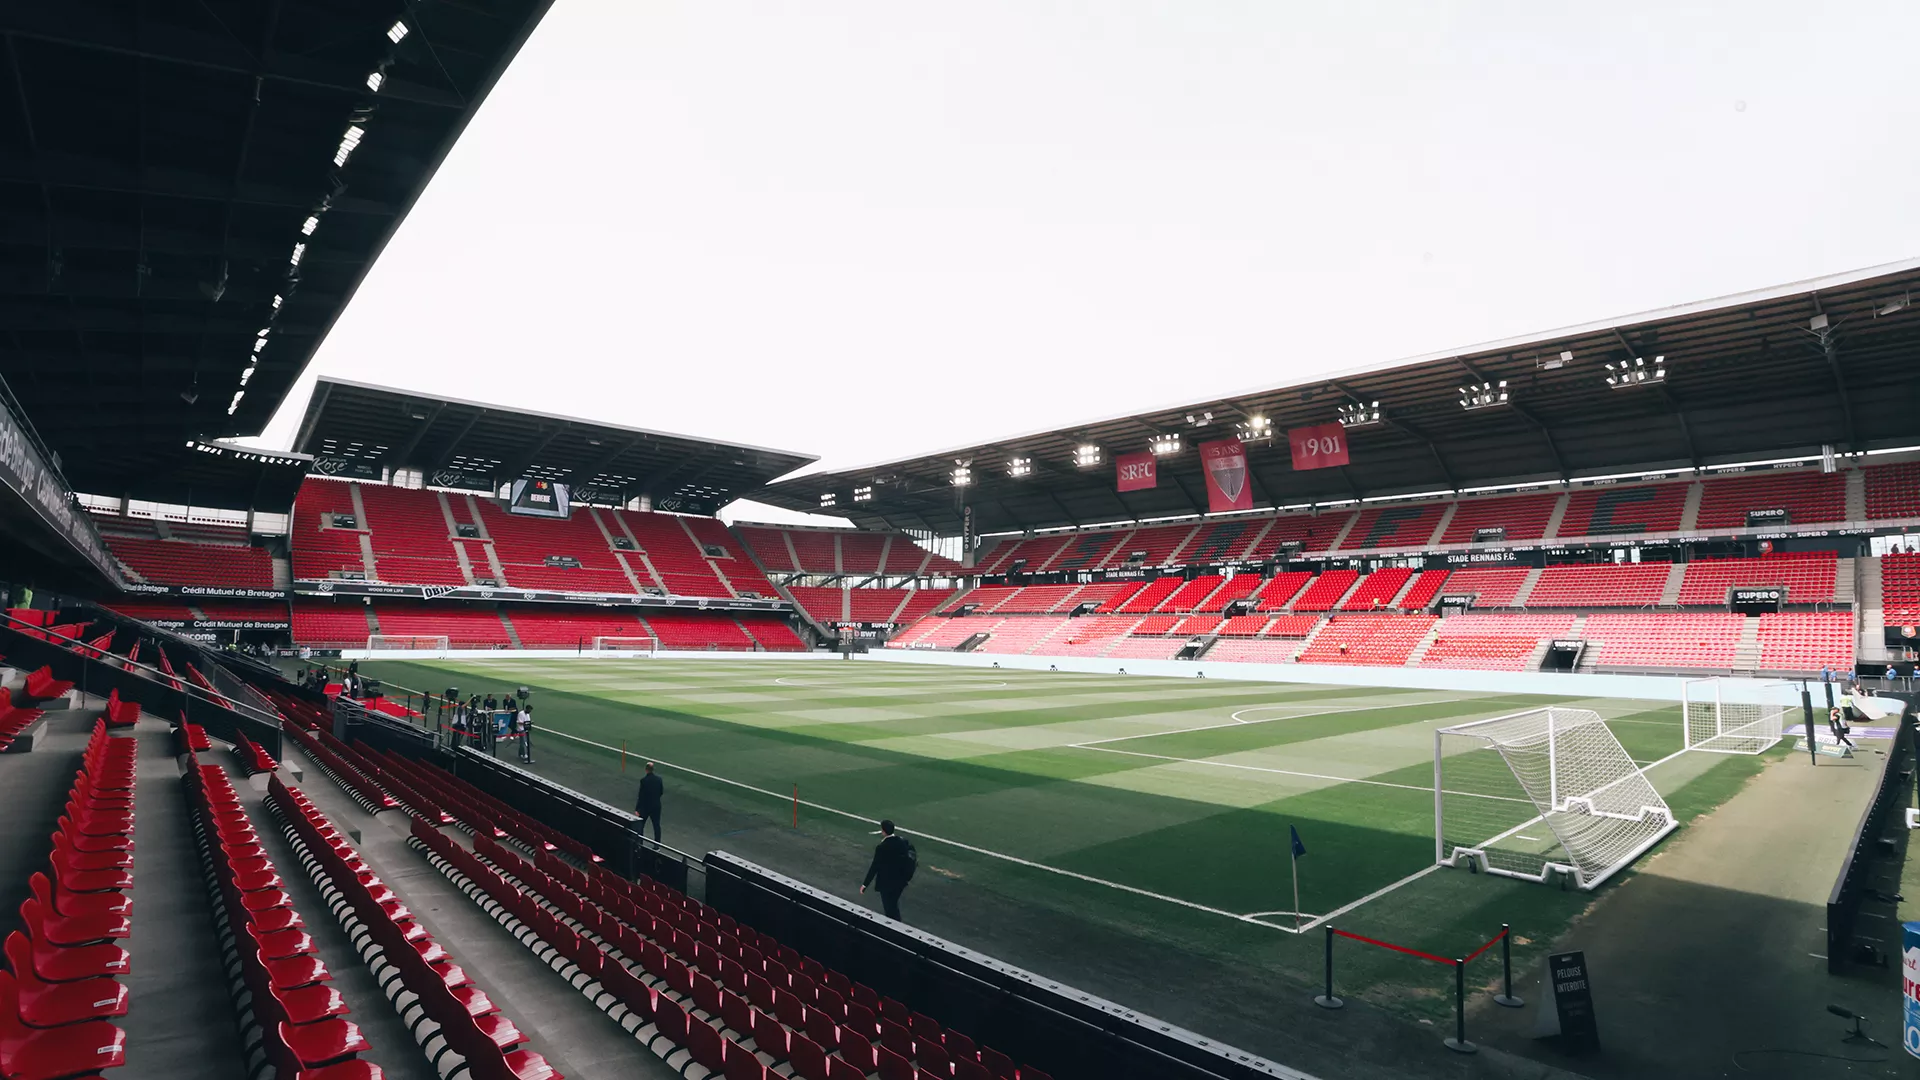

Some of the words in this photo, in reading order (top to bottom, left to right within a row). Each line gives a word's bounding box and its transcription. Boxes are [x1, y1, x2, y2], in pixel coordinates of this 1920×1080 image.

[1221, 444, 1240, 456] ANS
[1300, 436, 1341, 458] 1901
[1120, 462, 1153, 480] SRFC
[1448, 554, 1469, 563] STADE
[1471, 553, 1502, 562] RENNAIS
[1503, 552, 1516, 560] F.C.
[142, 584, 169, 593] Bretagne
[206, 587, 235, 596] Mutuel
[247, 589, 285, 598] Bretagne
[1737, 591, 1769, 599] SUPER
[157, 621, 185, 629] Bretagne
[194, 620, 216, 628] Crédit
[254, 622, 288, 630] Bretagne
[1556, 966, 1582, 979] PELOUSE
[1557, 980, 1587, 993] INTERDITE
